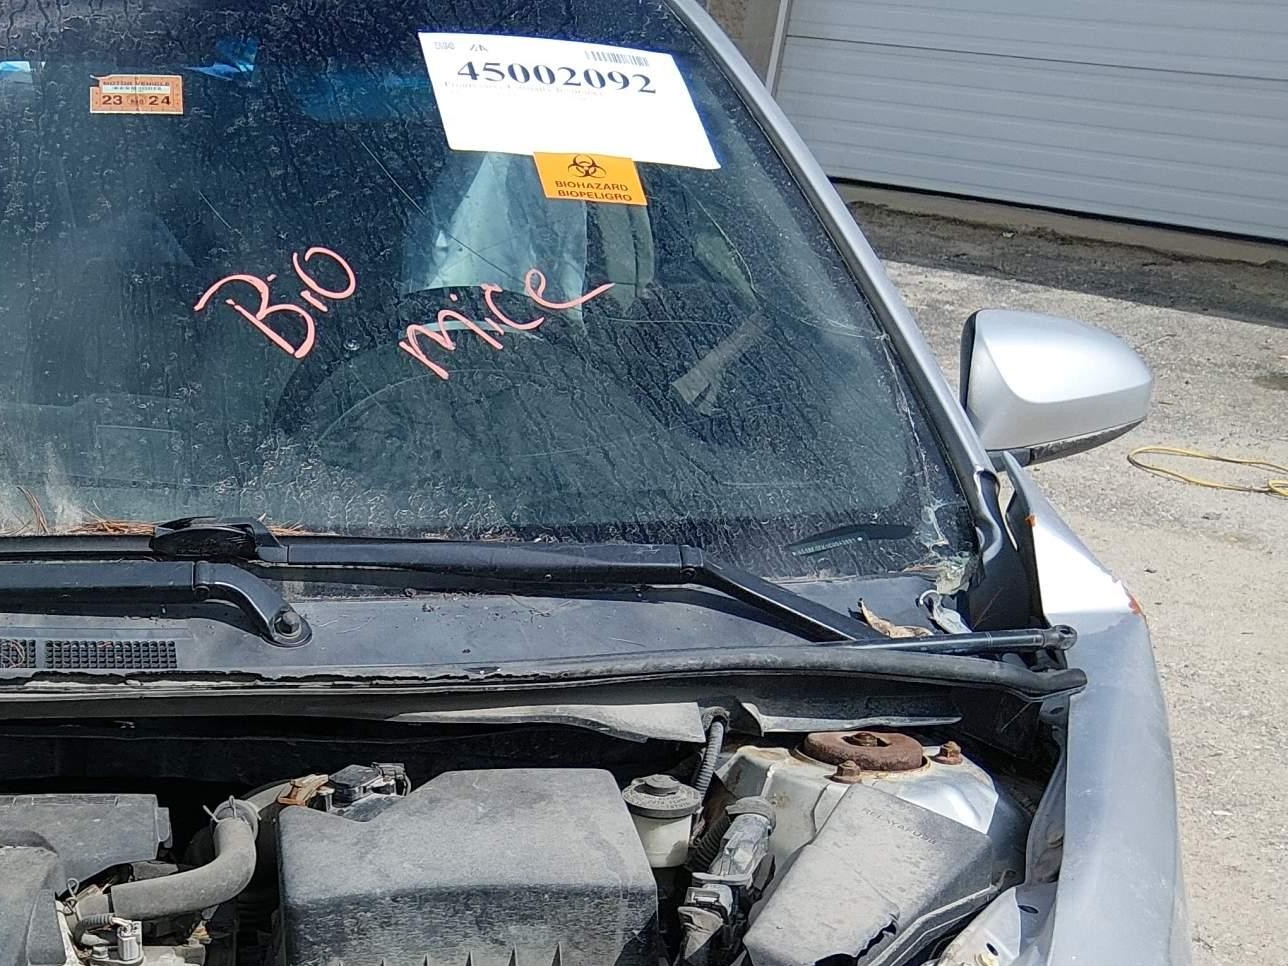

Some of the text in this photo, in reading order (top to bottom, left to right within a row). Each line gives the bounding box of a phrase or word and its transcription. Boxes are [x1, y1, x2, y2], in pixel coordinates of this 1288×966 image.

[456, 60, 657, 95] 45002092
[102, 94, 122, 105] 23
[149, 95, 170, 105] 24
[554, 180, 629, 192] BIOHAZARD
[557, 189, 633, 202] BIOPELIGRO
